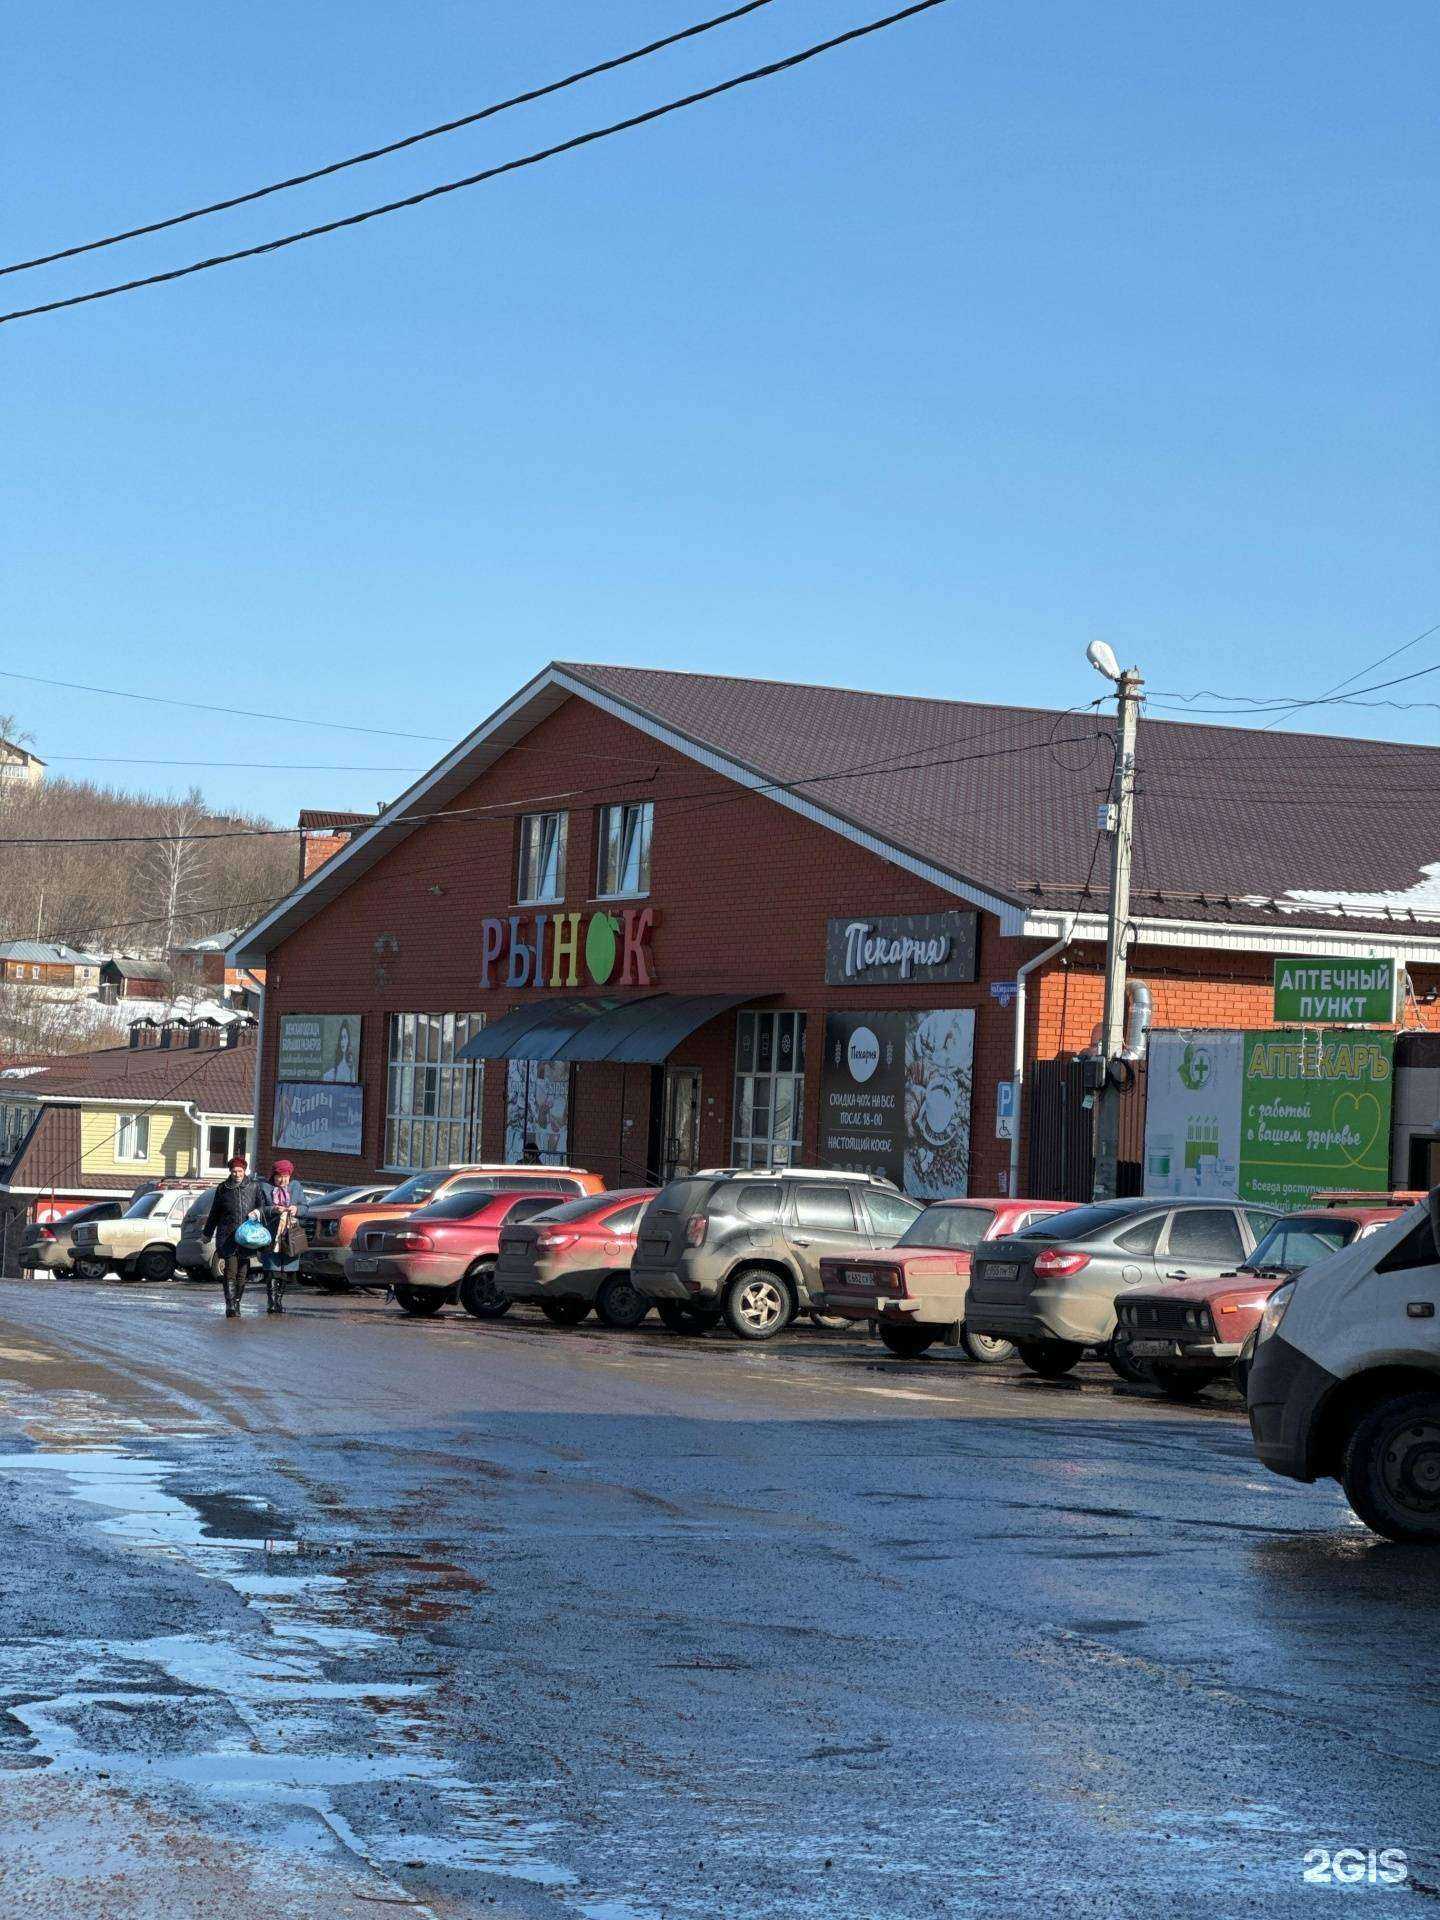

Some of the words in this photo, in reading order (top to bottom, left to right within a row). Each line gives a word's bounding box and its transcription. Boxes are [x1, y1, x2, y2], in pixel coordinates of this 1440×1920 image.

[479, 908, 659, 989] РЫНОК
[845, 922, 946, 978] Пекарня
[1280, 964, 1390, 990] АПТЕЧНЫЙ
[1300, 996, 1367, 1018] ПУНКТ
[851, 1045, 877, 1064] Пекарня
[1248, 1104, 1255, 1117] с
[1258, 1097, 1311, 1123] заботой
[828, 1135, 870, 1151] НАСТОЯЩИЙ
[870, 1138, 892, 1152] КОФЕ
[1258, 1122, 1302, 1145] вашем
[1306, 1124, 1361, 1150] здоровье
[1252, 1179, 1281, 1195] Всегда
